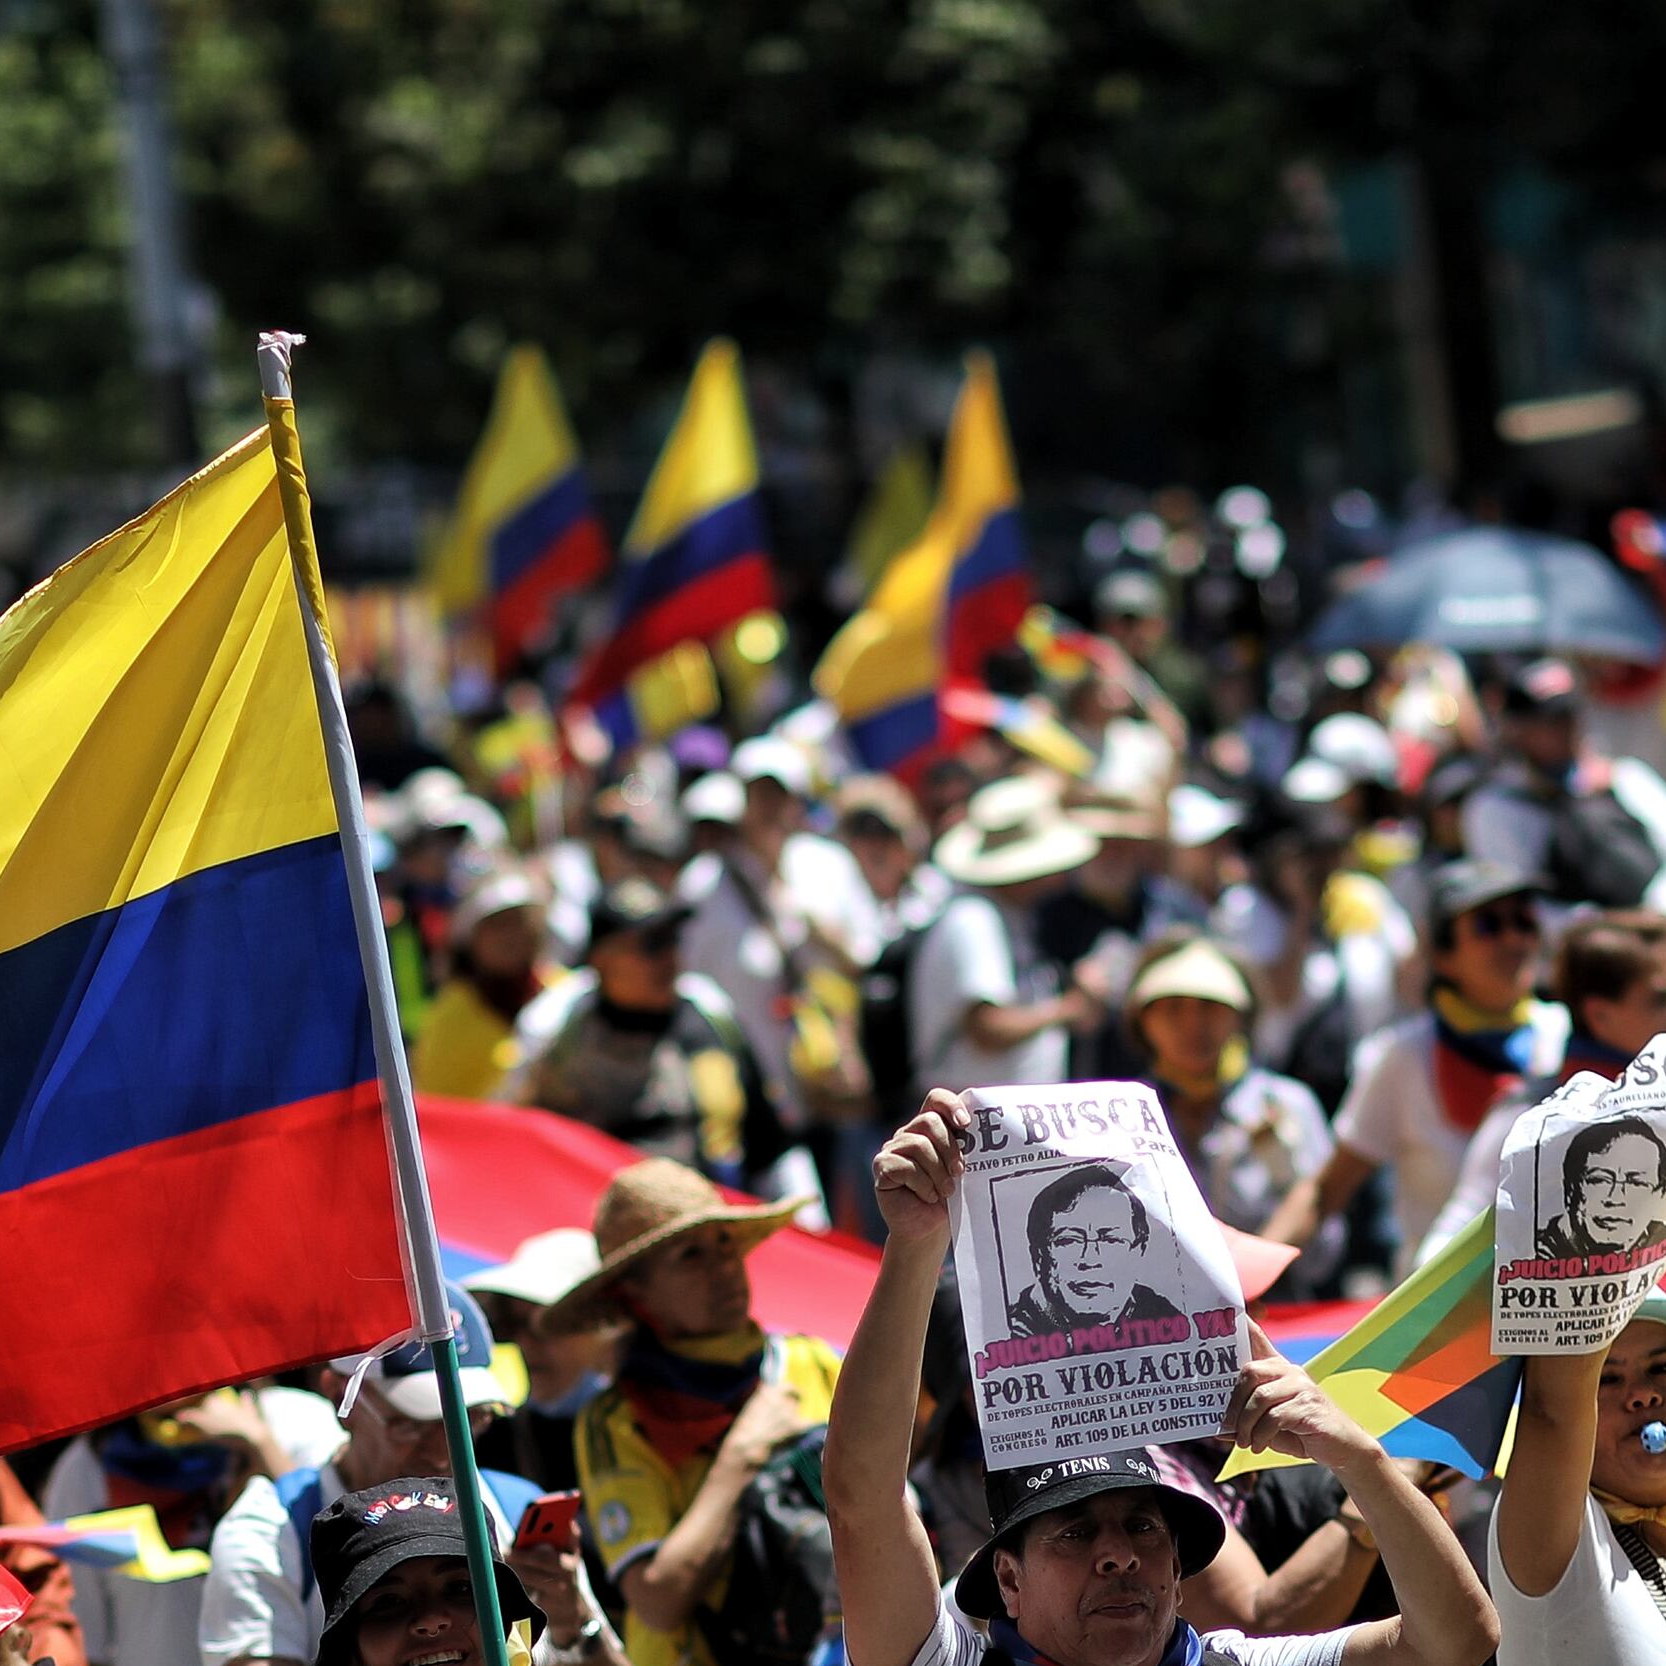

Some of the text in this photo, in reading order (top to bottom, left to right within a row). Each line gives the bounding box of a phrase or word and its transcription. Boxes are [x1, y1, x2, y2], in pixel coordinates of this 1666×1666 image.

[1017, 1097, 1165, 1146] BUSCA
[1132, 1136, 1177, 1157] Para
[964, 1148, 1068, 1173] STAVO PETRO ALIA
[1499, 1286, 1560, 1309] POR
[1192, 1307, 1237, 1340] YA!
[1500, 1311, 1512, 1319] DE
[1513, 1310, 1541, 1319] TOPES
[1555, 1318, 1605, 1332] APLICAR
[1554, 1335, 1581, 1347] ART.
[1584, 1332, 1603, 1345] 109
[981, 1342, 1240, 1409] POR VIOLACIÓN
[987, 1411, 1001, 1422] DE
[1001, 1406, 1033, 1420] TOPES
[1109, 1391, 1122, 1403] EN
[1124, 1384, 1174, 1401] CAMPAÑA
[1175, 1377, 1237, 1394] PRESIDENCI
[1051, 1407, 1108, 1430] APLICAR
[1110, 1405, 1129, 1420] LA
[1130, 1401, 1155, 1416] LEY
[1158, 1399, 1168, 1412] 5
[1170, 1396, 1196, 1411] DEL
[1198, 1394, 1214, 1407] 92
[1217, 1392, 1227, 1406] Y
[989, 1427, 1047, 1445] EXIGIMOS AL
[991, 1437, 1048, 1454] CONGRESO
[1054, 1432, 1084, 1449] ART.
[1085, 1428, 1109, 1444] 109
[1111, 1424, 1130, 1440] DE
[1131, 1421, 1150, 1437] LA
[1057, 1456, 1111, 1478] TENIS
